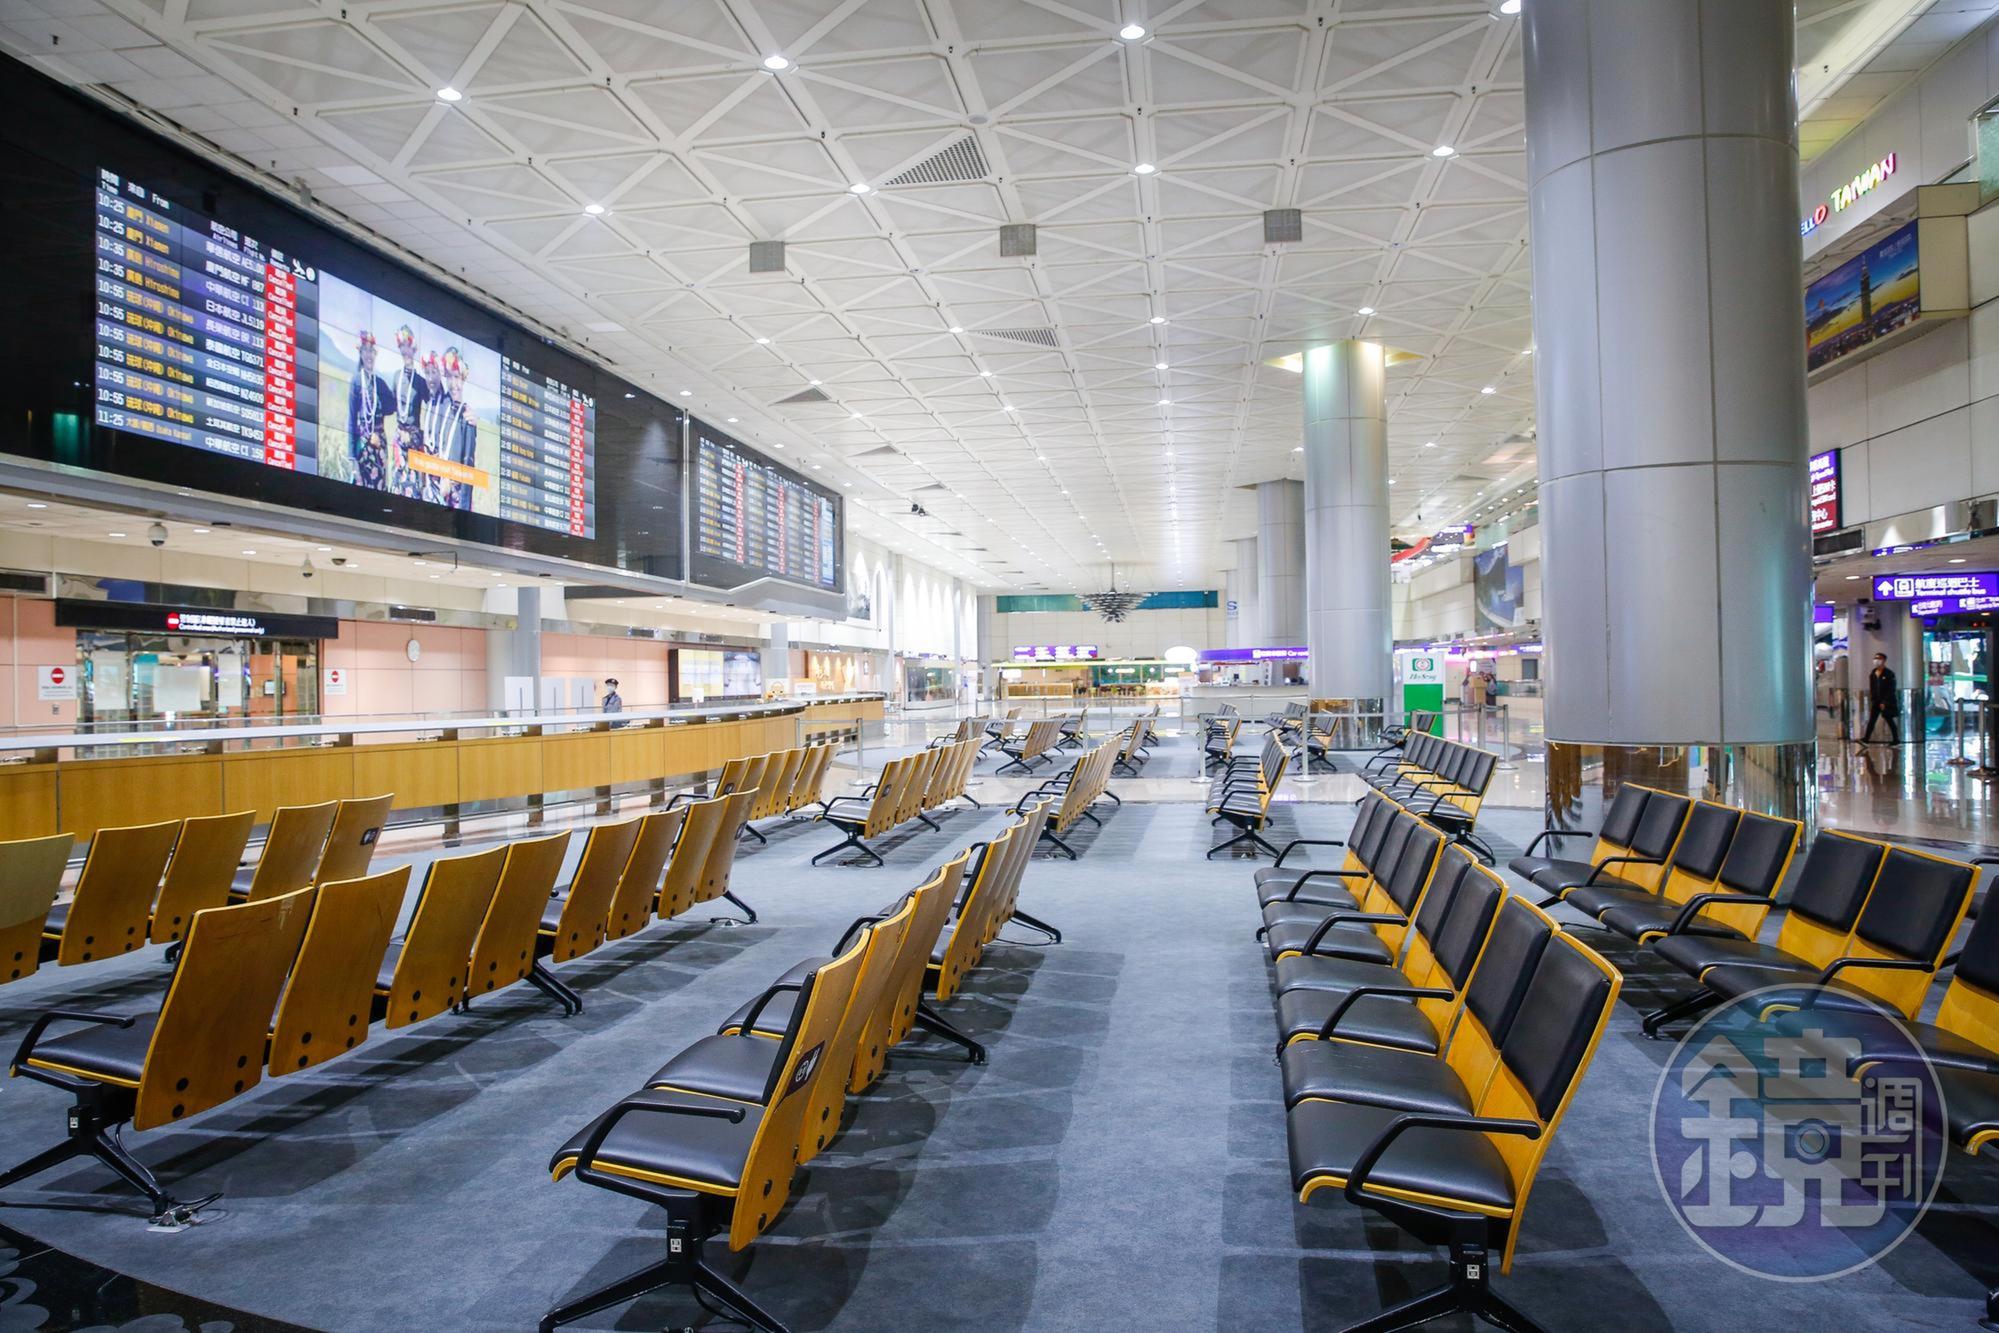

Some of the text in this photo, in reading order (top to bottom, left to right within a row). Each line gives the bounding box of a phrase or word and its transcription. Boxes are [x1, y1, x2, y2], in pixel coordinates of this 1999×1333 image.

[98, 193, 125, 215] 10:25
[98, 214, 125, 236] 10:25
[1801, 205, 1828, 235] ELLO
[98, 236, 125, 257] 10:35
[98, 258, 125, 278] 10:35
[98, 279, 125, 299] 10:55
[98, 300, 125, 319] 10:55
[98, 322, 125, 341] 10:55
[98, 343, 125, 362] 10:55
[98, 365, 125, 383] 10:55
[98, 387, 125, 404] 10:55
[98, 409, 125, 425] 11:25
[1915, 588, 1946, 596] Terminal
